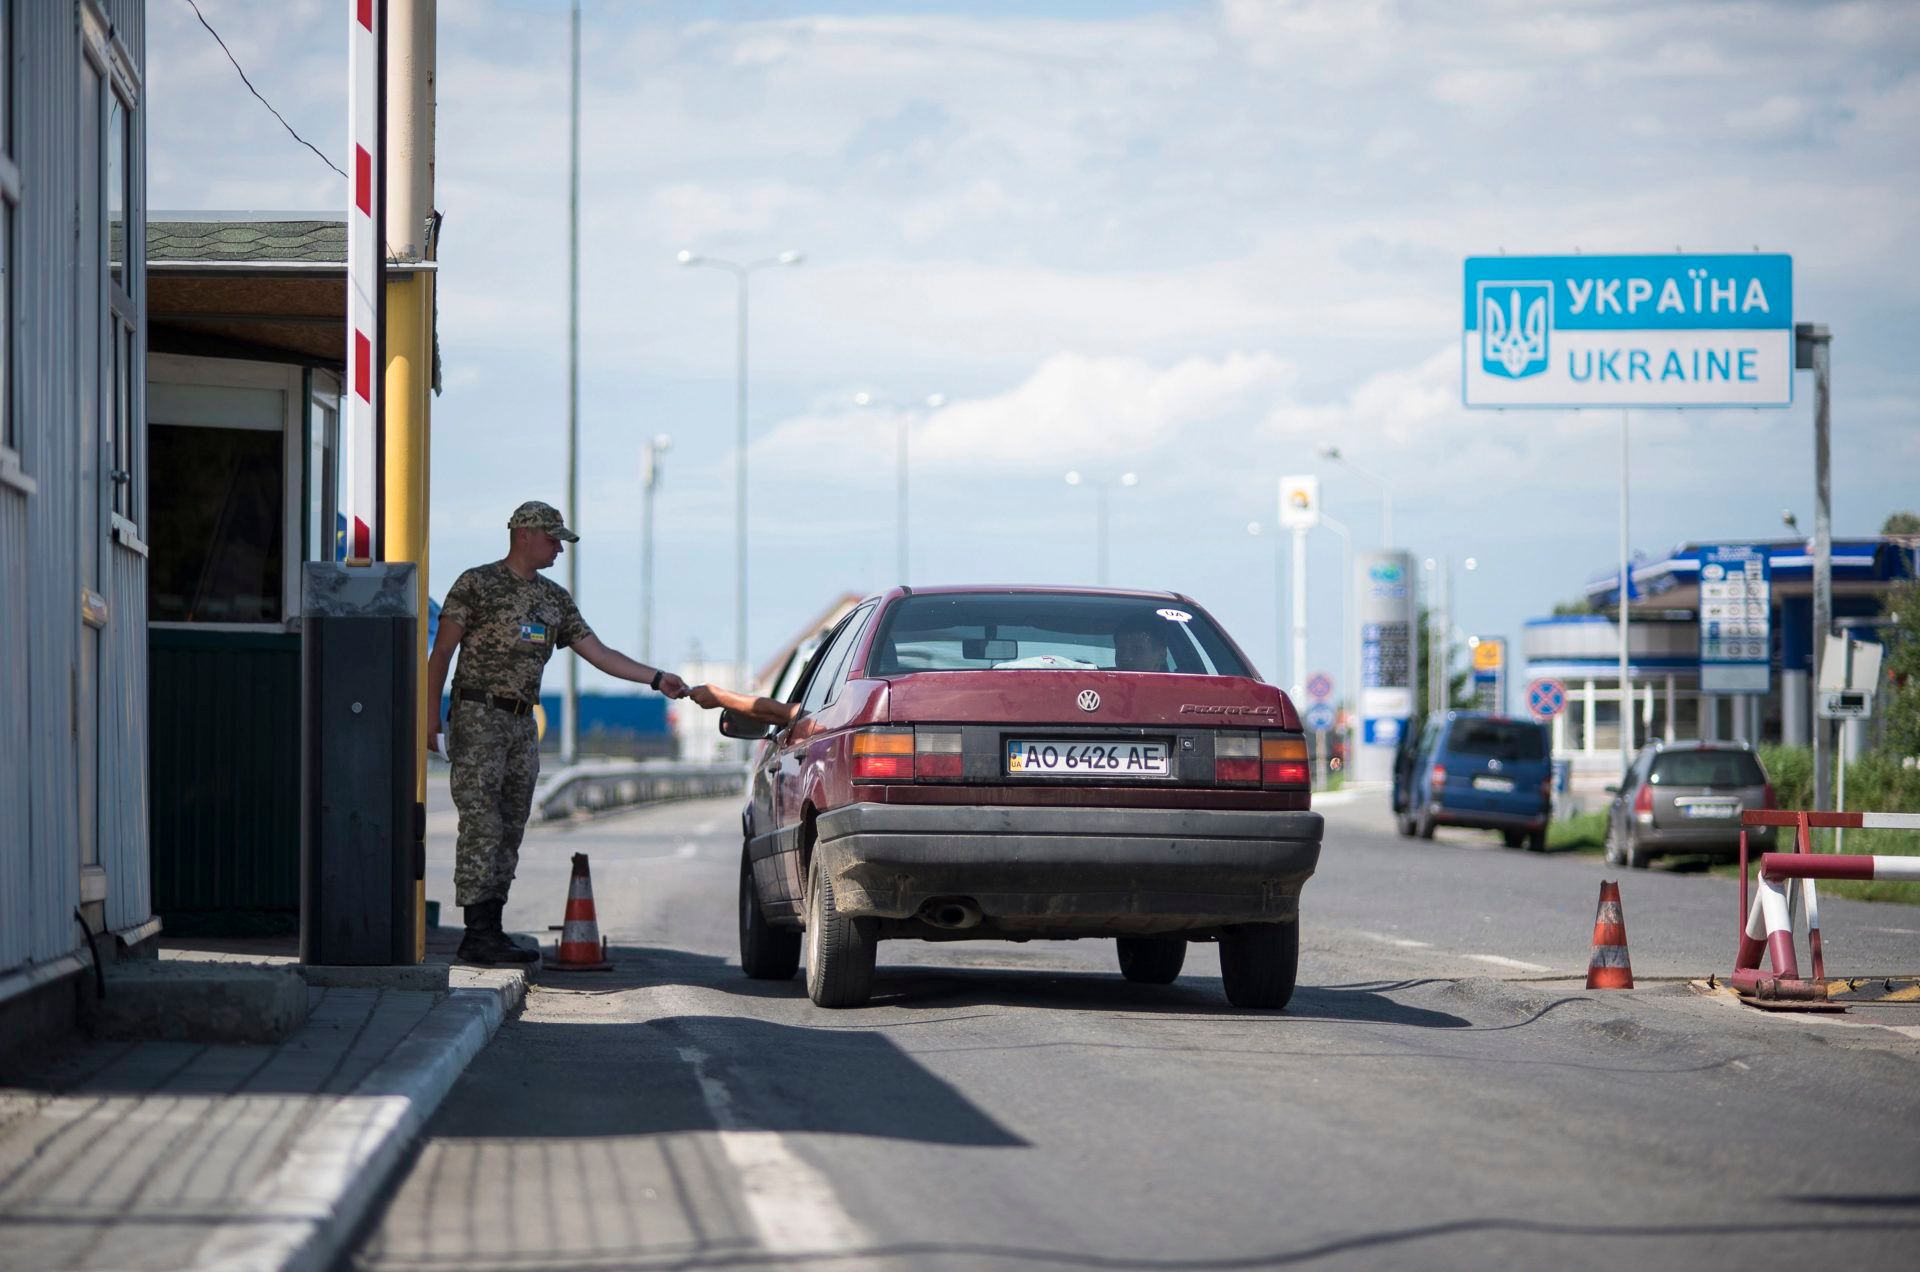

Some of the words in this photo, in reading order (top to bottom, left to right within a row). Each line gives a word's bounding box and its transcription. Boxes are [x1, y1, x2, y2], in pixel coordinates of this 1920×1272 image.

[1566, 268, 1770, 314] УКРАЇНА
[1569, 349, 1759, 382] UKRAINE
[1025, 745, 1059, 768] AO
[1065, 745, 1119, 769] 6426
[1127, 747, 1161, 770] AE
